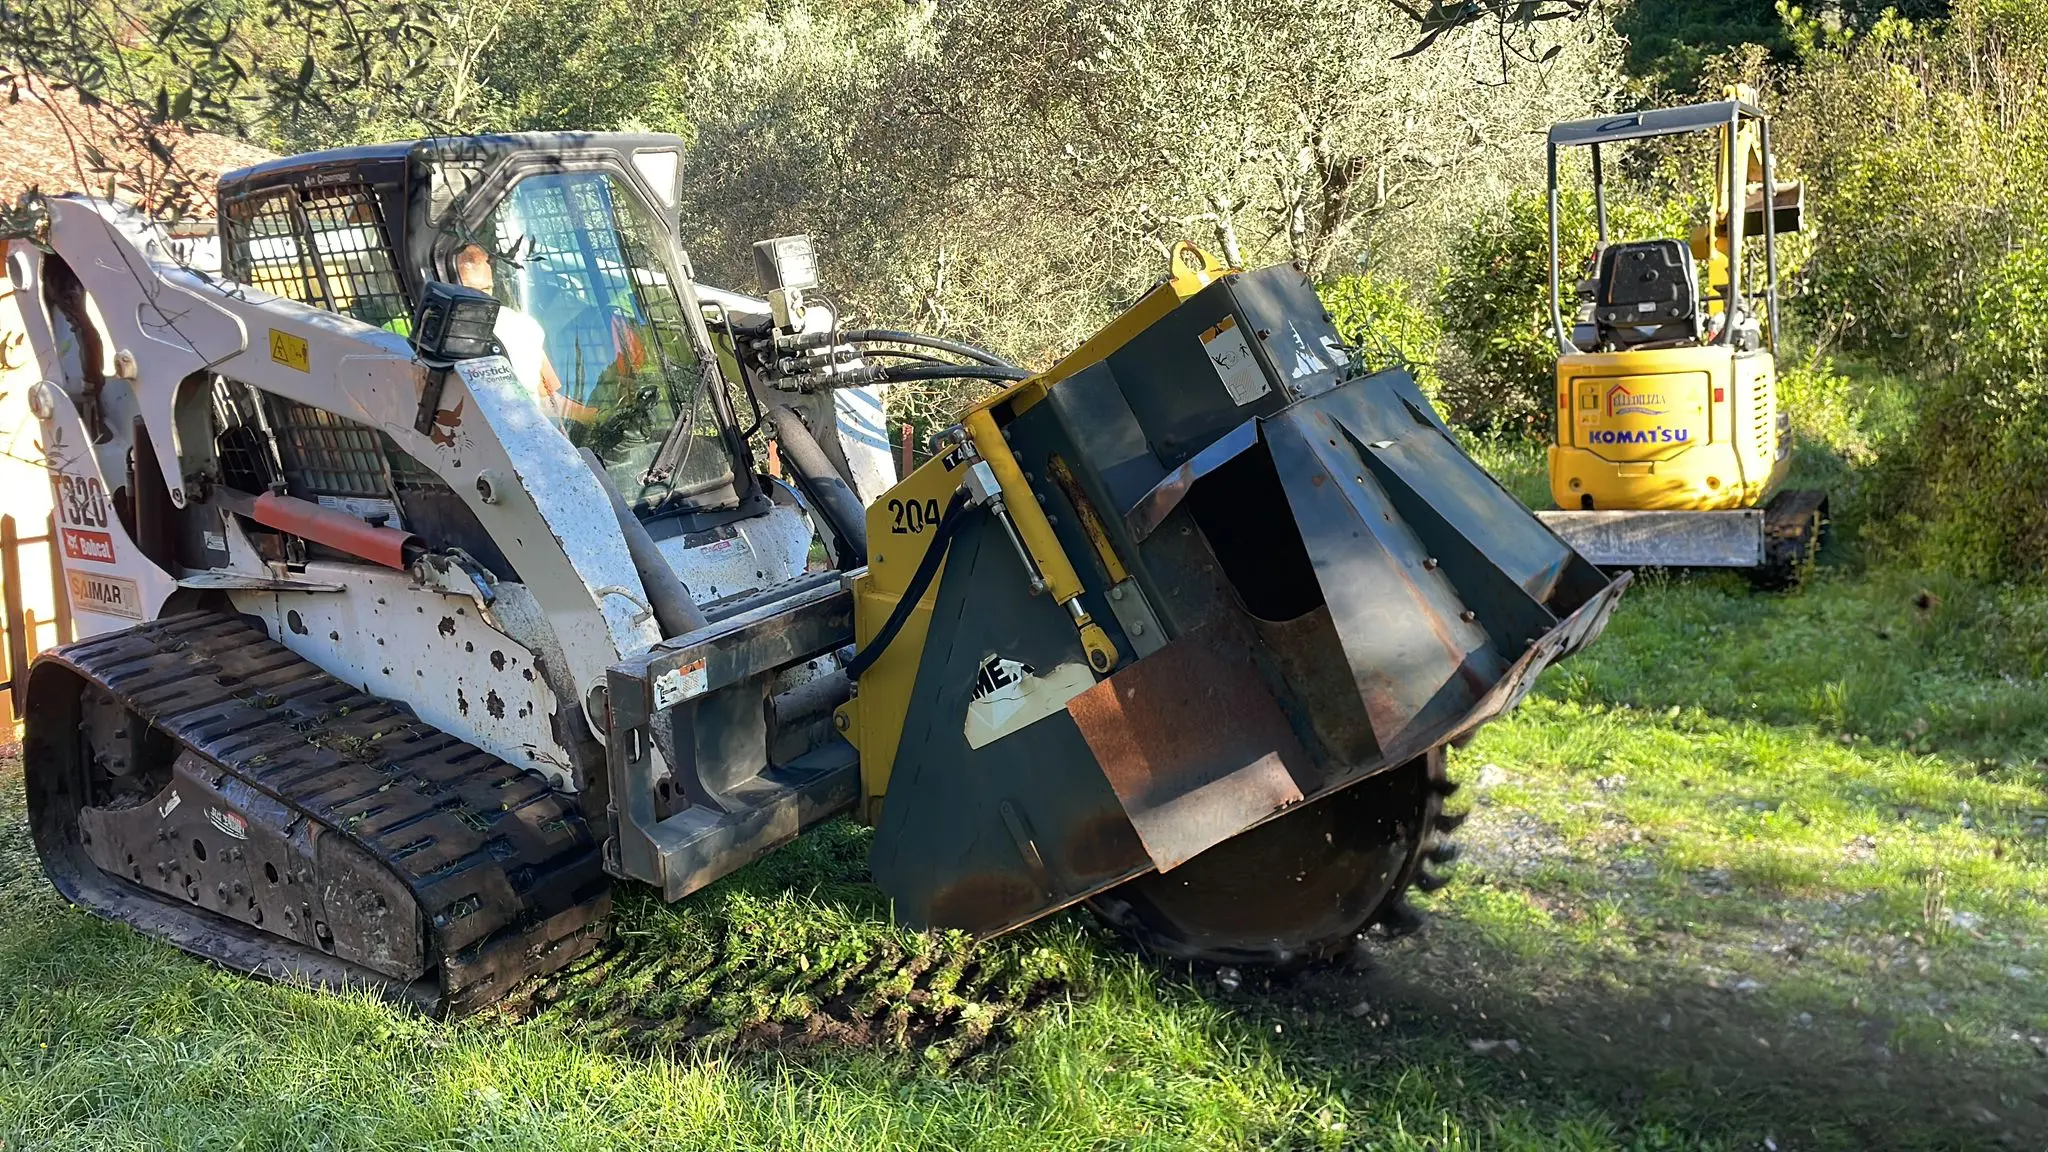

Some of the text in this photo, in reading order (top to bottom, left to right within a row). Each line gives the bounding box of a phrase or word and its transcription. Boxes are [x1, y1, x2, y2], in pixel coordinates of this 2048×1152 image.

[1589, 426, 1688, 444] KOMATSU
[51, 475, 108, 528] T320
[888, 498, 941, 534] 204
[80, 537, 112, 558] Bobcat
[71, 576, 122, 604] SAIMAR
